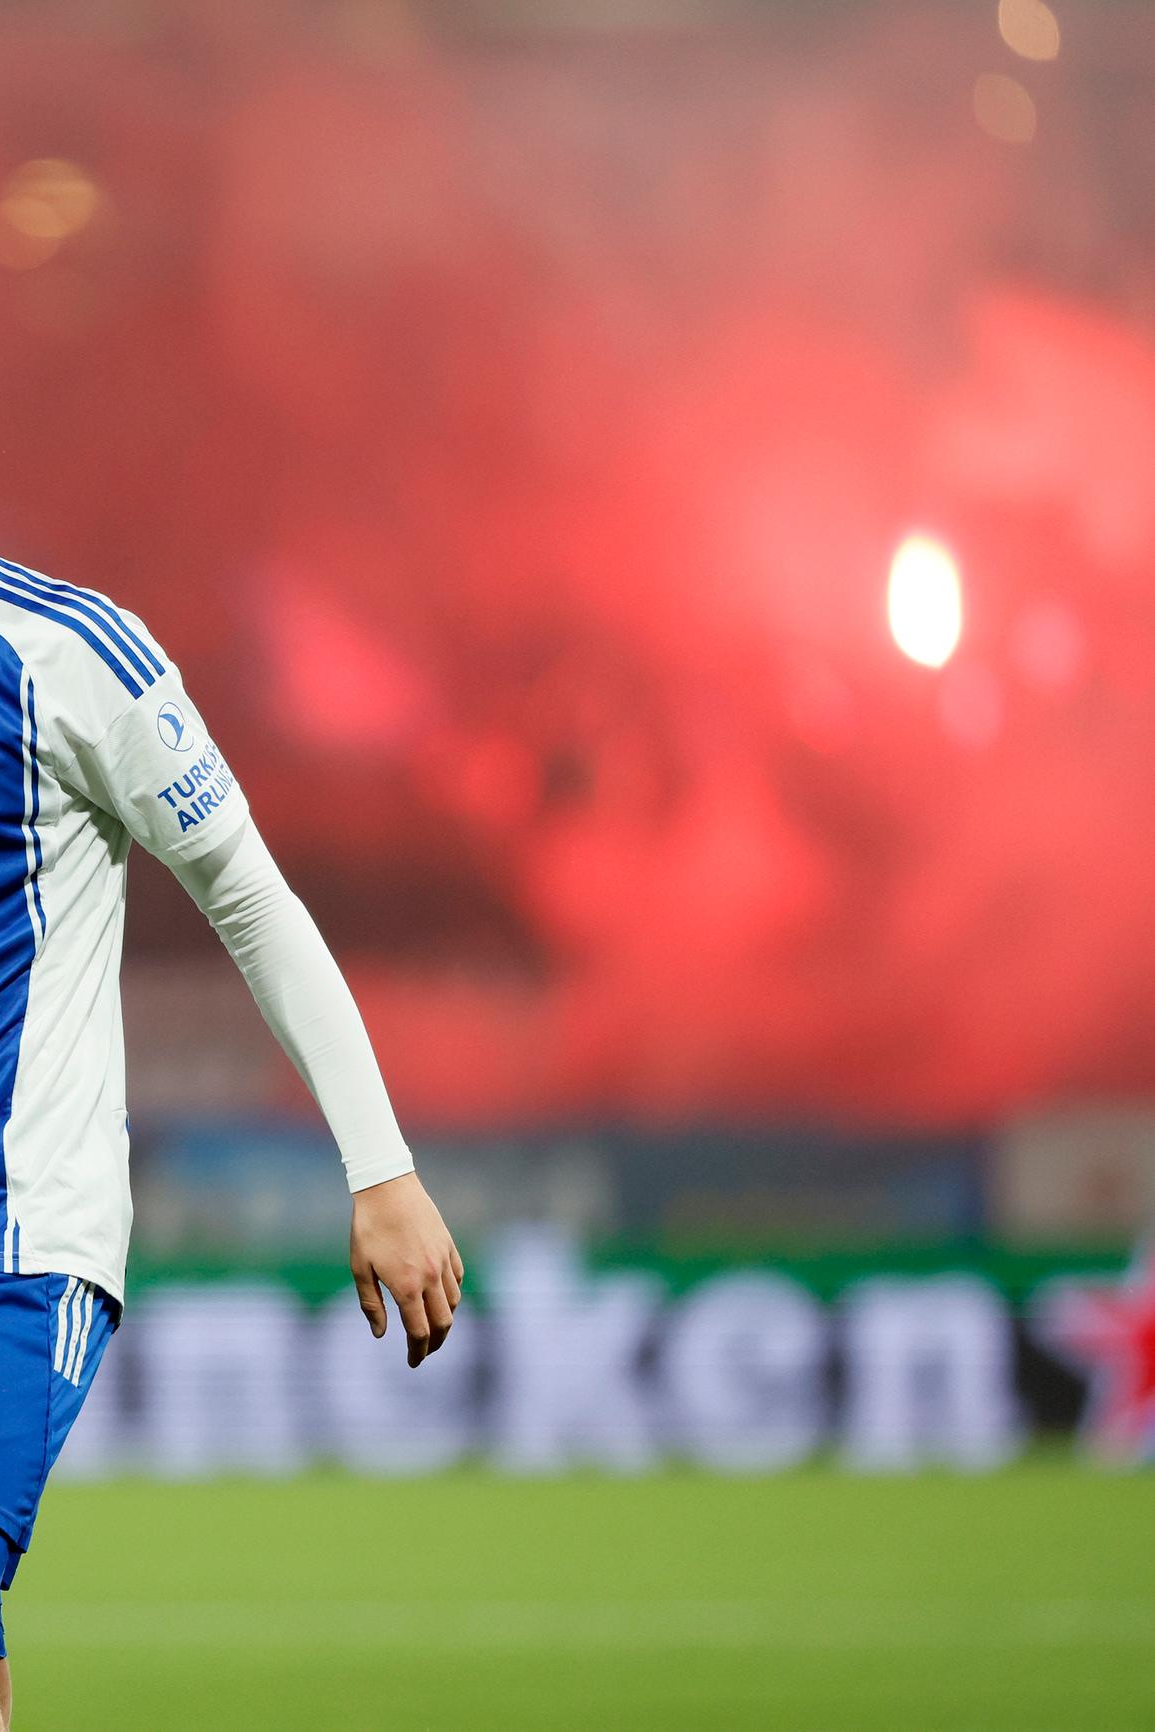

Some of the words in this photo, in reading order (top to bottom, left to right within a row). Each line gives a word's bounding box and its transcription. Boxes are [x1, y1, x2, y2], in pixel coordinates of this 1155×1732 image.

[157, 741, 219, 809] TURKIS
[176, 763, 234, 833] AIRLINE
[51, 1228, 1021, 1477] neken
